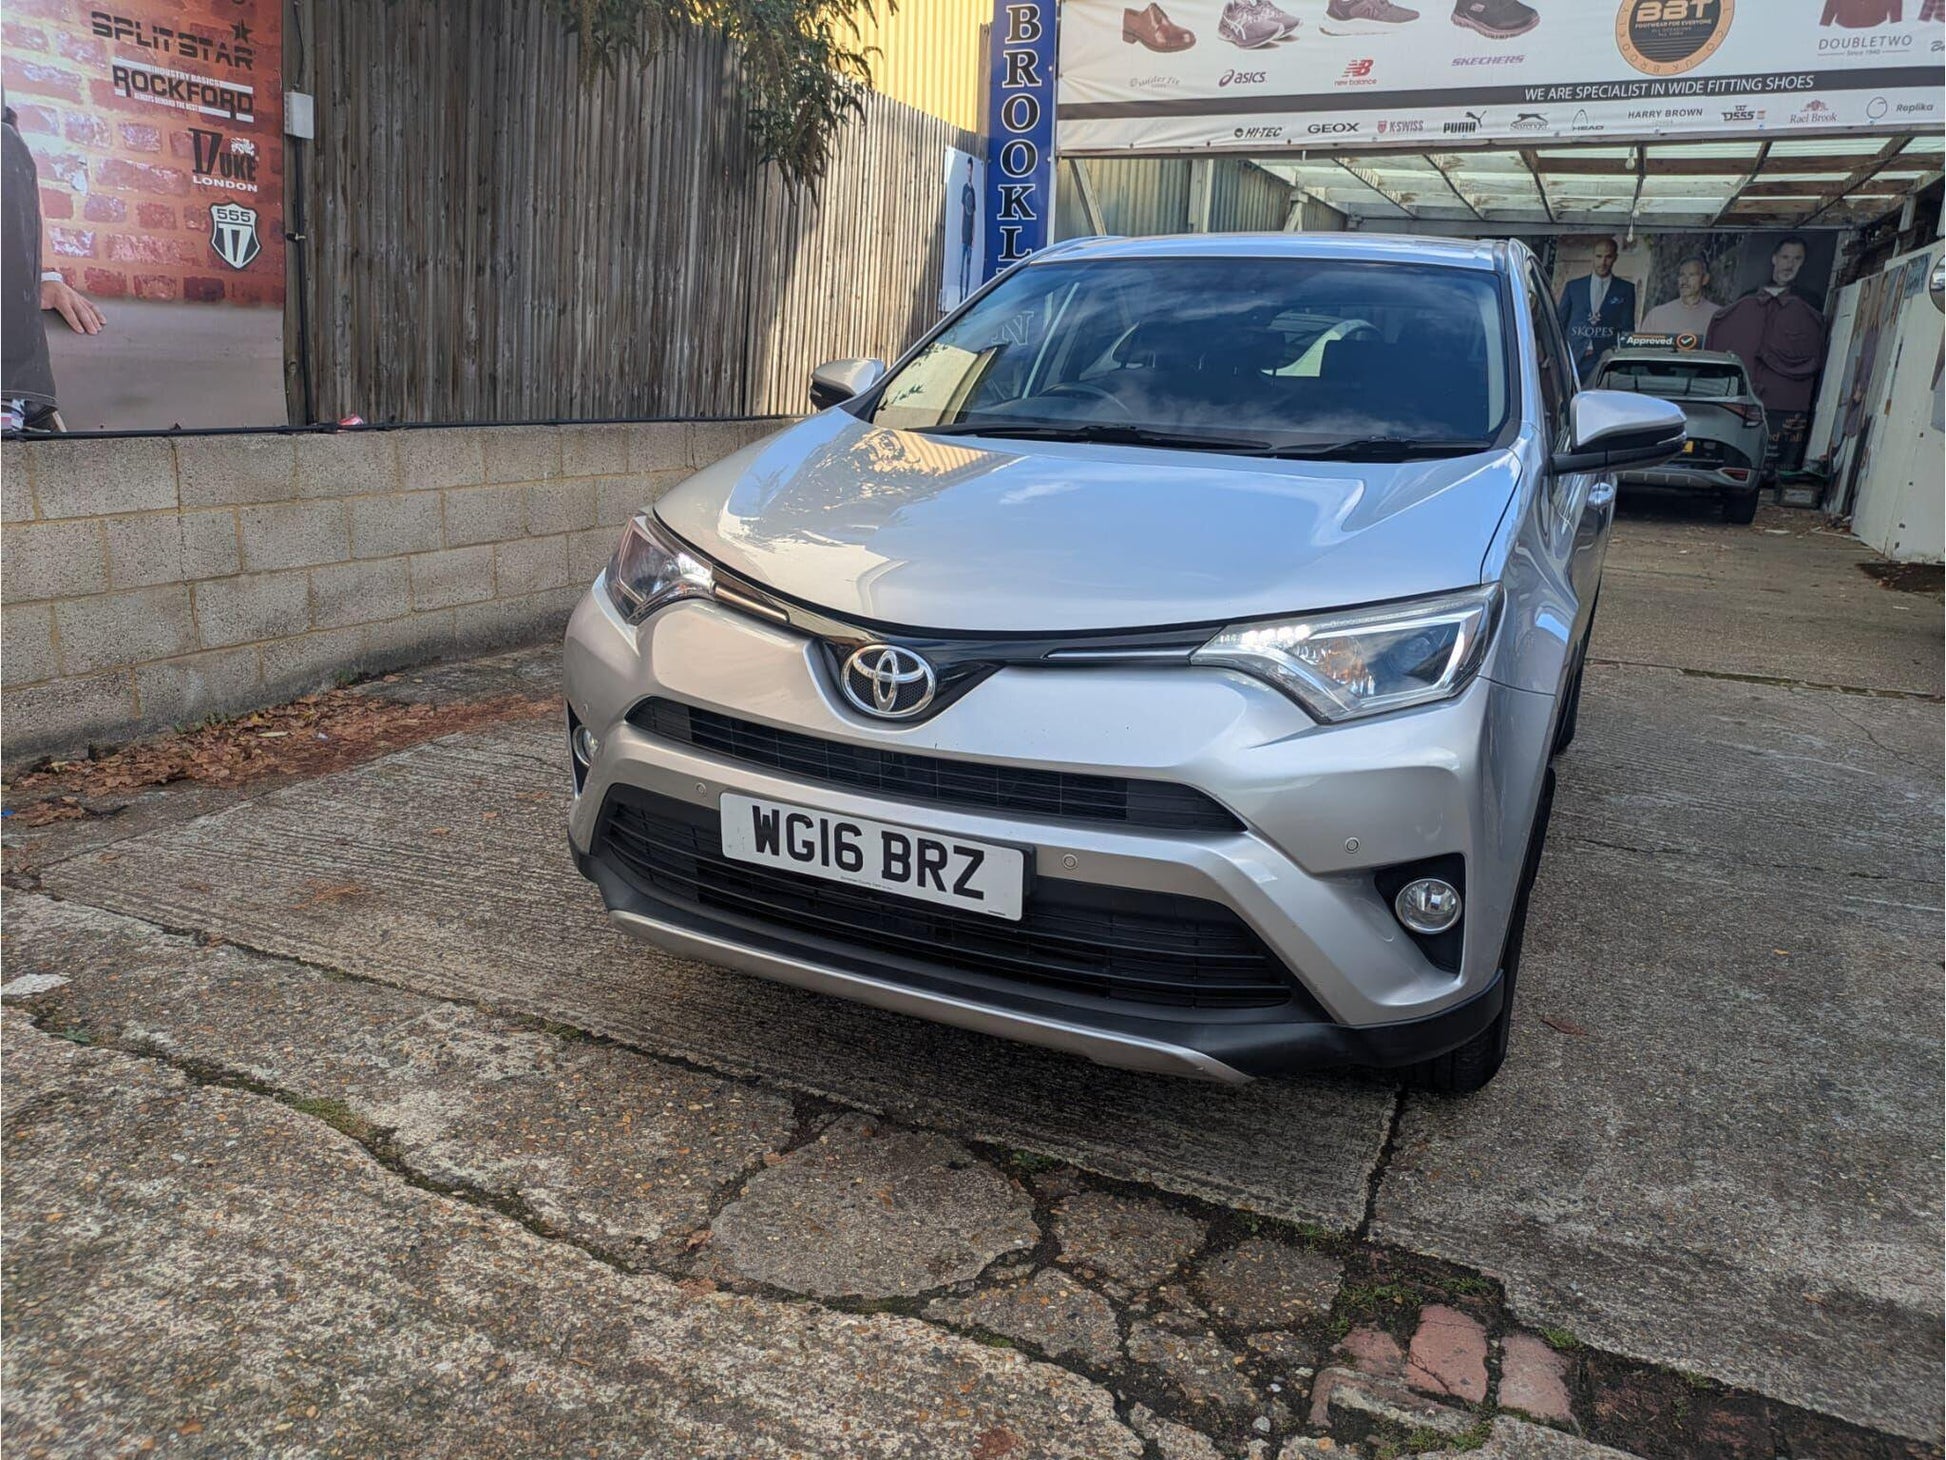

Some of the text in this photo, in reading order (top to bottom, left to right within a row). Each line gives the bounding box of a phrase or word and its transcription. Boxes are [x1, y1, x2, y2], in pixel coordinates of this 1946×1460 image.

[1636, 0, 1713, 22] BBT
[1818, 35, 1912, 50] DOUBLETWO
[1451, 54, 1526, 67] SKECHERS
[1350, 78, 1378, 87] balance
[1525, 75, 1815, 101] WE ARE SPECIALIST IN WIDE FITTING SHOES
[112, 64, 254, 120] ROCKFORD
[1628, 108, 1704, 119] HARRY BROWN
[1307, 122, 1361, 134] GEOX
[1442, 121, 1477, 134] PUMA
[193, 175, 258, 193] LONDON
[216, 208, 251, 223] 555
[1571, 325, 1614, 338] SKOPES
[1626, 335, 1673, 347] Approved
[752, 805, 985, 901] WG16 BRZ
